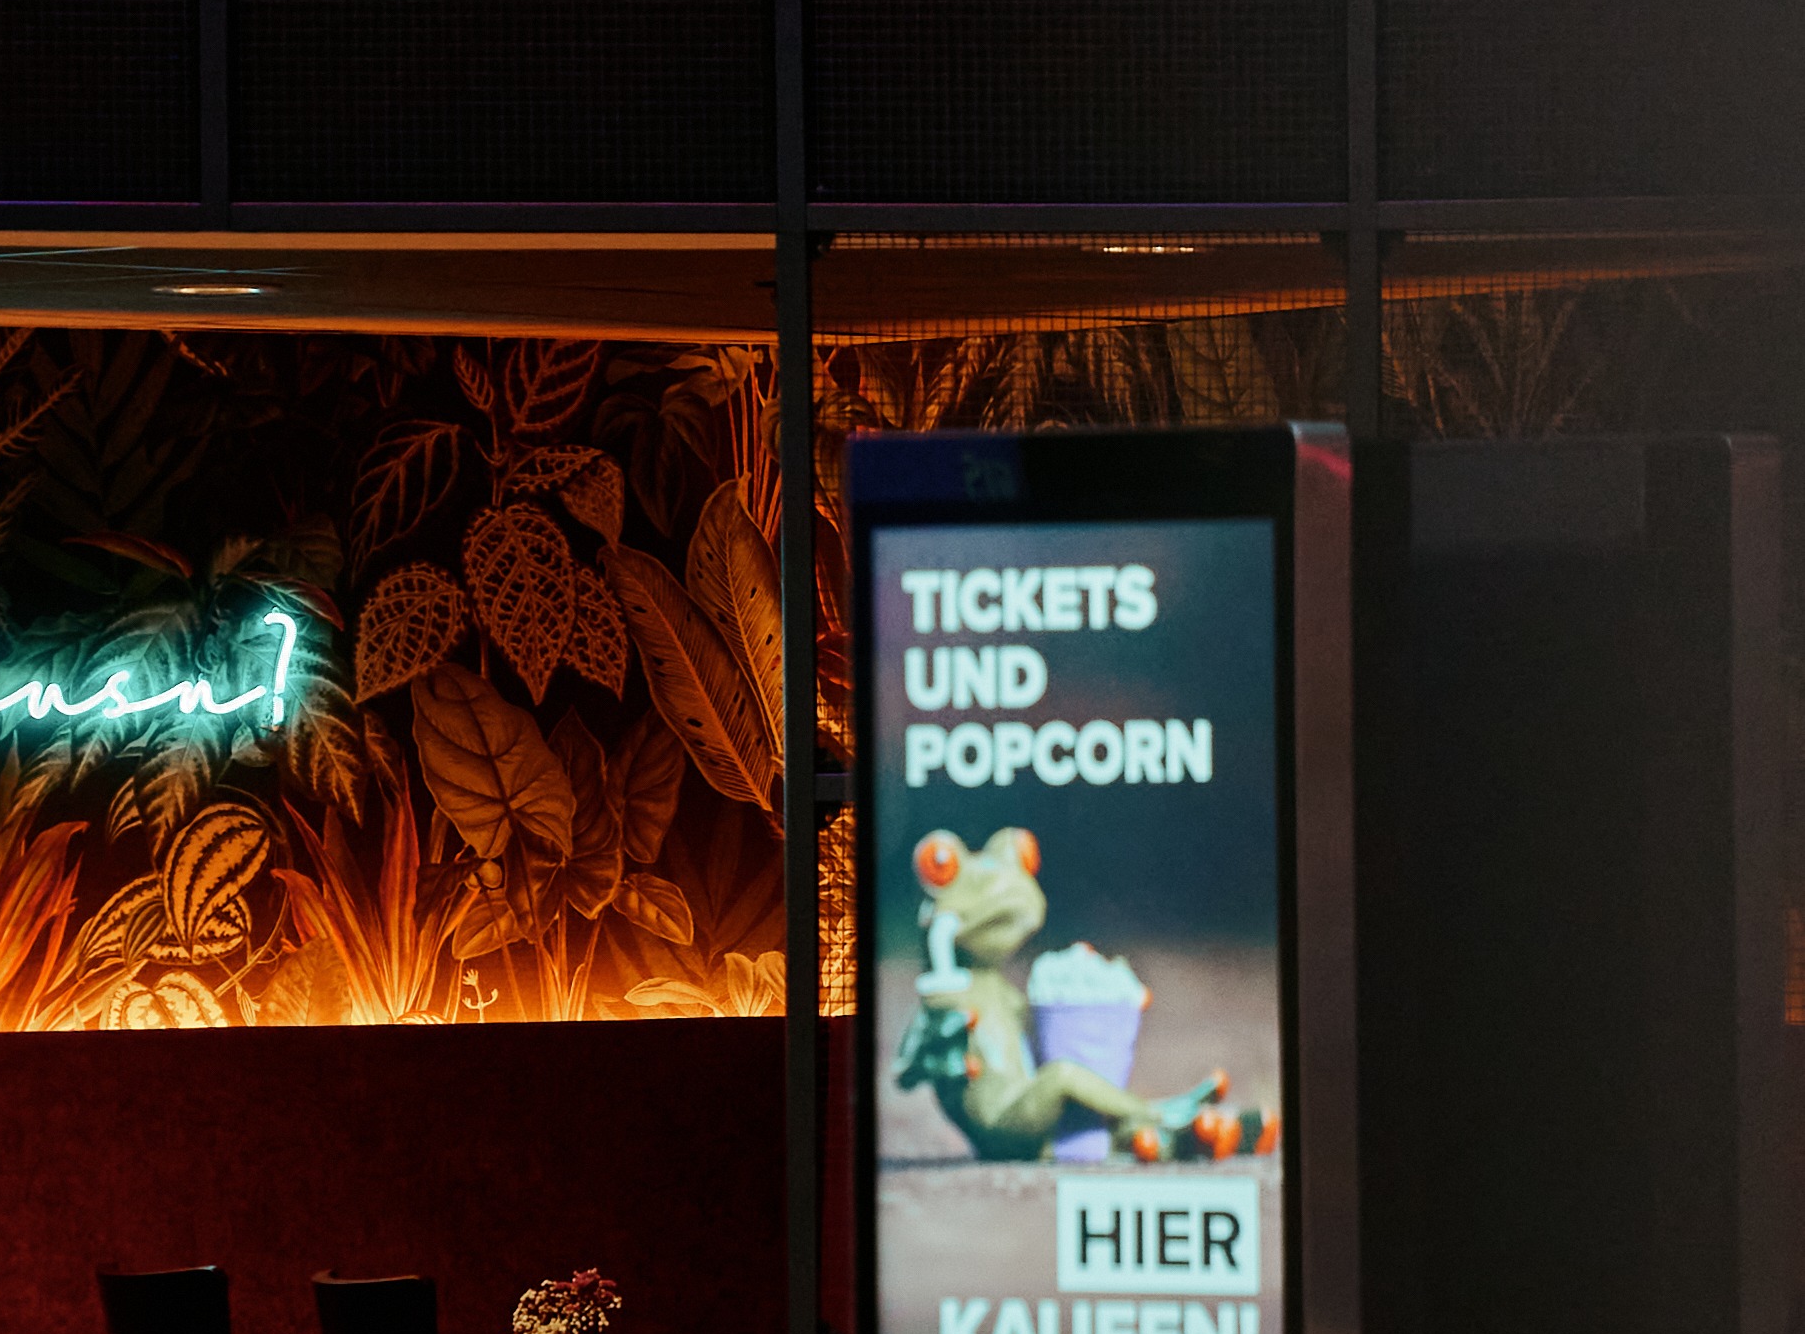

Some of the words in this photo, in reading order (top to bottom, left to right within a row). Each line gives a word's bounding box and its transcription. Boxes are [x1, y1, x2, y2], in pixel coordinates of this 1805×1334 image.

[902, 565, 1158, 633] TICKETS
[904, 645, 1049, 710] UND
[905, 719, 1212, 787] POPCORN
[1080, 1209, 1240, 1268] HIER
